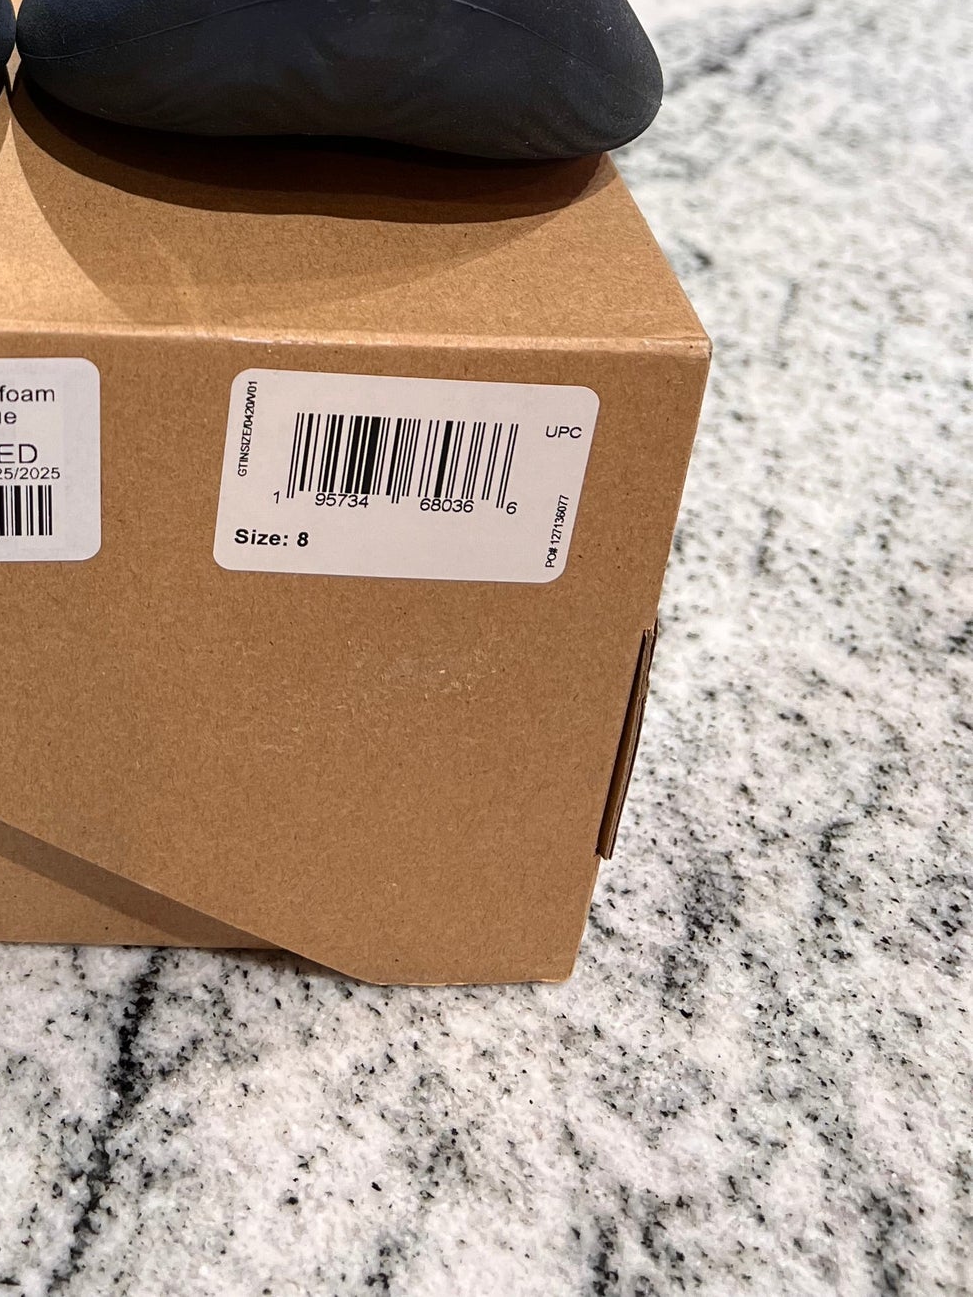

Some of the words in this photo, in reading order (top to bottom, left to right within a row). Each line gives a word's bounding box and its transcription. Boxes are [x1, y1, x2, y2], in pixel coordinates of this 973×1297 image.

[545, 425, 583, 440] UPC
[272, 490, 281, 505] 1
[314, 493, 371, 509] 95734
[419, 497, 475, 514] 68036
[505, 501, 518, 517] 6
[549, 494, 570, 546] 127136077
[233, 528, 289, 547] Size:
[296, 531, 310, 548] 8
[544, 546, 559, 569] PO#
